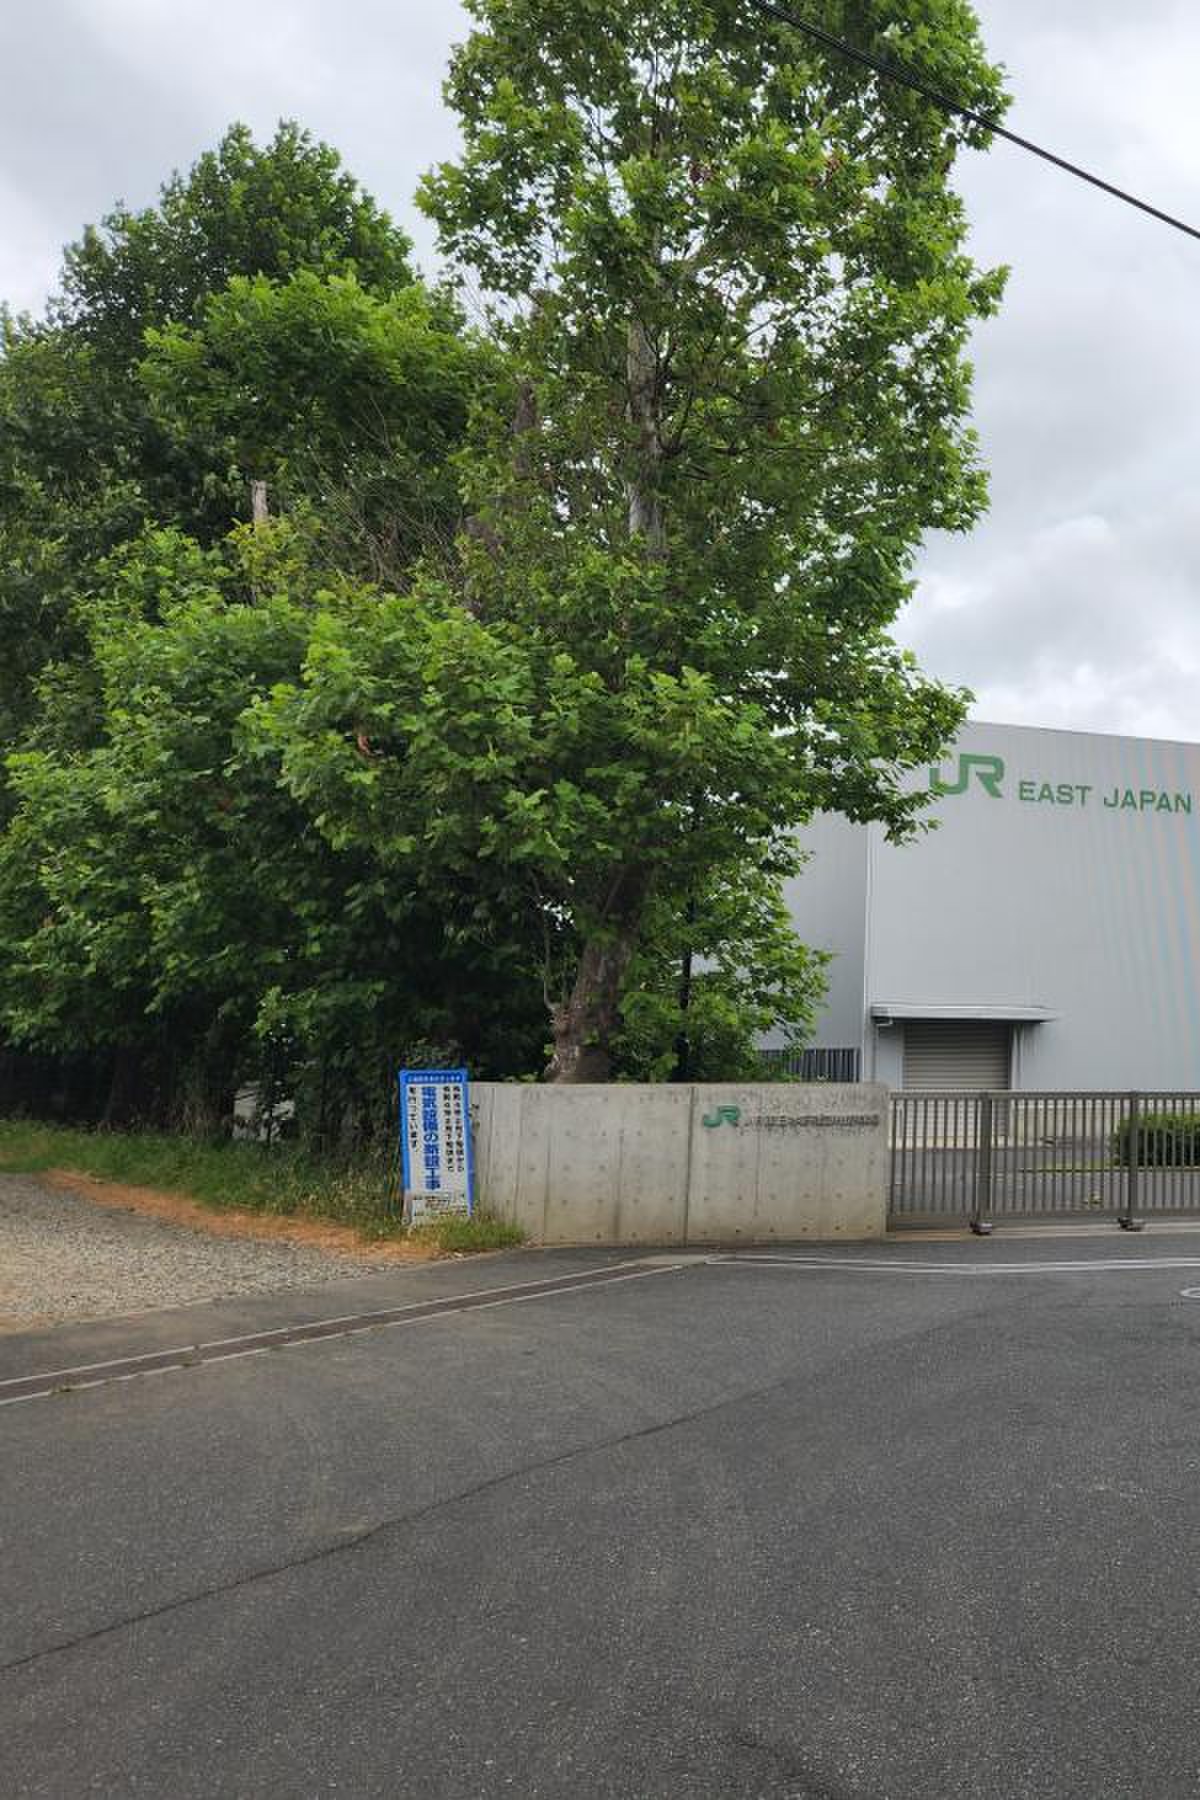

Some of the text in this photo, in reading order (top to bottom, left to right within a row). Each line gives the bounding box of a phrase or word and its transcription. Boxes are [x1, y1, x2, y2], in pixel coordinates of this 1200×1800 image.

[930, 753, 1005, 799] JR
[1018, 781, 1092, 807] EAST
[1104, 788, 1191, 814] JAPAN
[702, 1105, 741, 1128] JR
